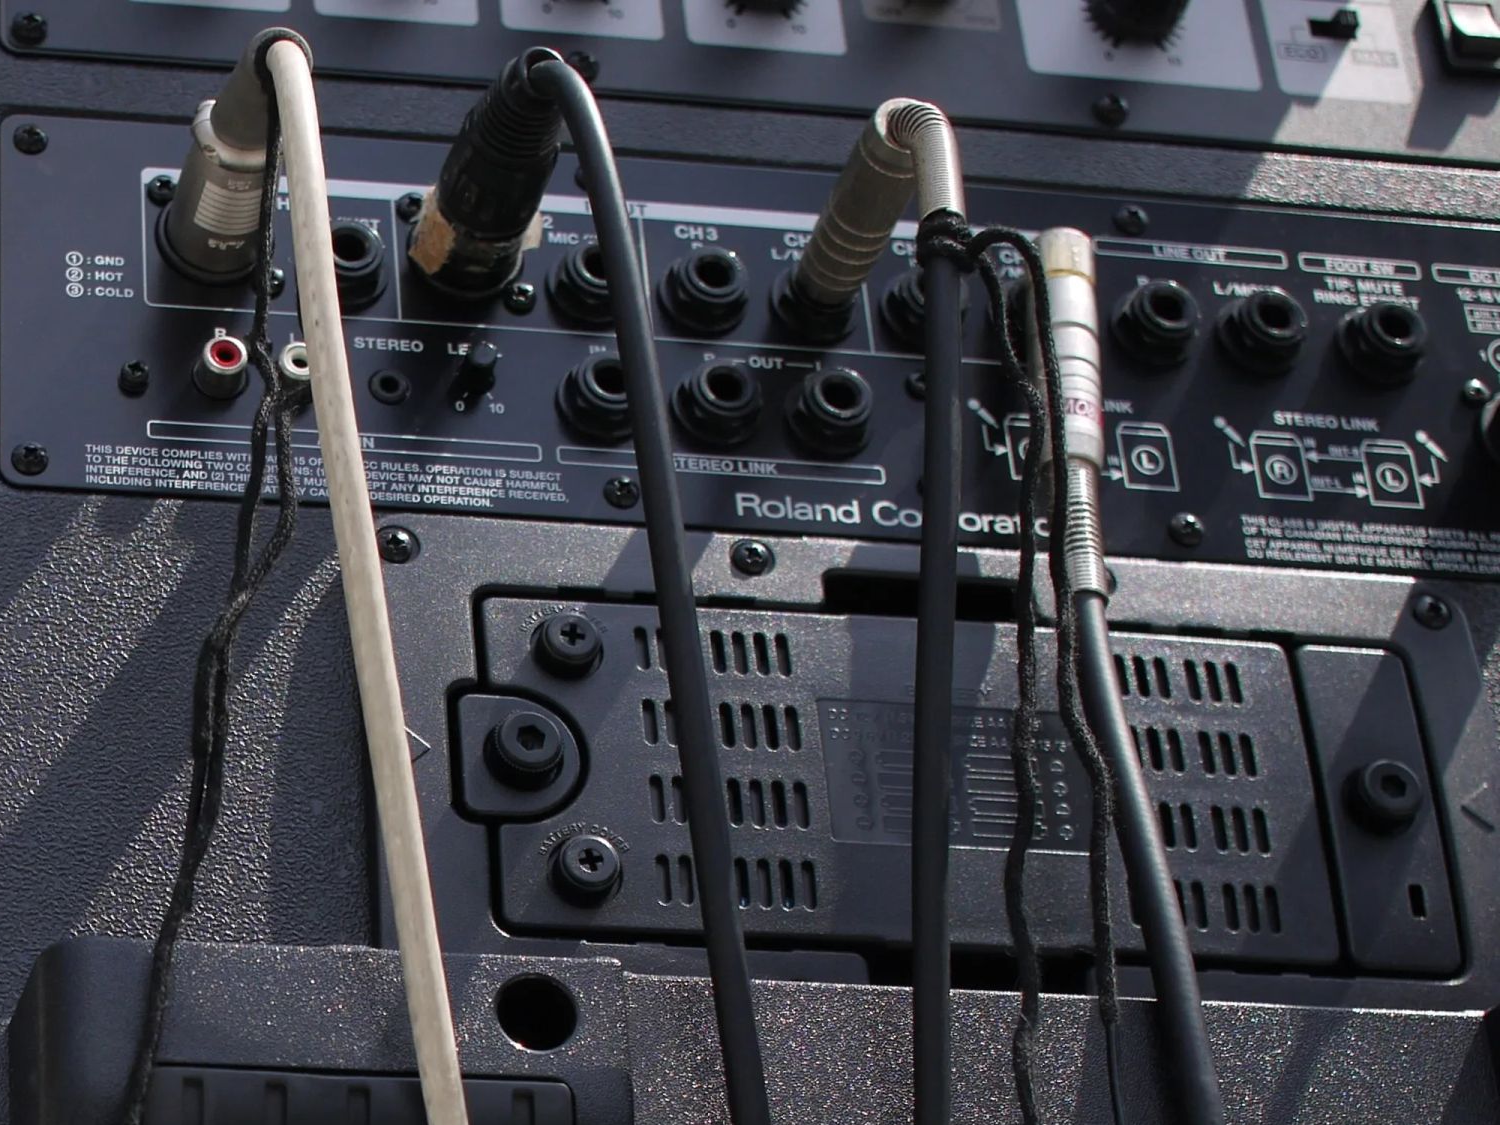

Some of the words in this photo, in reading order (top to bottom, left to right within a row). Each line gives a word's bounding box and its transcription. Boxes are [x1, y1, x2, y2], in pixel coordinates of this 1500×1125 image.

[548, 232, 579, 245] MIC
[94, 255, 125, 267] GND
[1192, 247, 1227, 261] OUT
[1325, 259, 1367, 274] FOOT
[1369, 262, 1396, 276] SW
[95, 271, 124, 282] HOT
[95, 287, 134, 298] COLD
[1324, 276, 1355, 292] TIP:
[1356, 279, 1404, 295] MUTE
[1313, 288, 1358, 306] RING:
[353, 336, 424, 352] STEREO
[748, 356, 784, 370] OUT
[455, 400, 465, 412] 0
[489, 403, 504, 414] 10
[1273, 410, 1338, 429] STEREO
[1341, 416, 1380, 432] LINK
[85, 444, 113, 455] THIS
[116, 446, 159, 457] DEVICE
[162, 448, 223, 460] COMPLIES
[381, 461, 422, 473] RULES.
[425, 464, 492, 477] OPERATION
[495, 469, 507, 478] IS
[509, 469, 562, 481] SUBJECT
[738, 460, 779, 476] LINK
[85, 454, 101, 464] TO
[105, 455, 129, 465] THE
[132, 457, 203, 470] FOLLOWING
[206, 461, 233, 471] TWO
[365, 471, 405, 482] DEVICE
[408, 474, 433, 483] MAY
[436, 475, 460, 485] NOT
[463, 476, 503, 488] CAUSE
[506, 479, 562, 491] HARMFUL
[85, 465, 179, 480] INTERFERENCE,
[182, 470, 207, 480] AND
[211, 471, 225, 482] (2)
[390, 483, 414, 493] ANY
[418, 485, 506, 498] INTERFERENCE
[85, 474, 152, 487] INCLUDING
[155, 479, 245, 493] INTERFERENCE
[370, 492, 420, 503] DESIRED
[423, 494, 494, 508] OPERATION.
[734, 492, 861, 524] Roland
